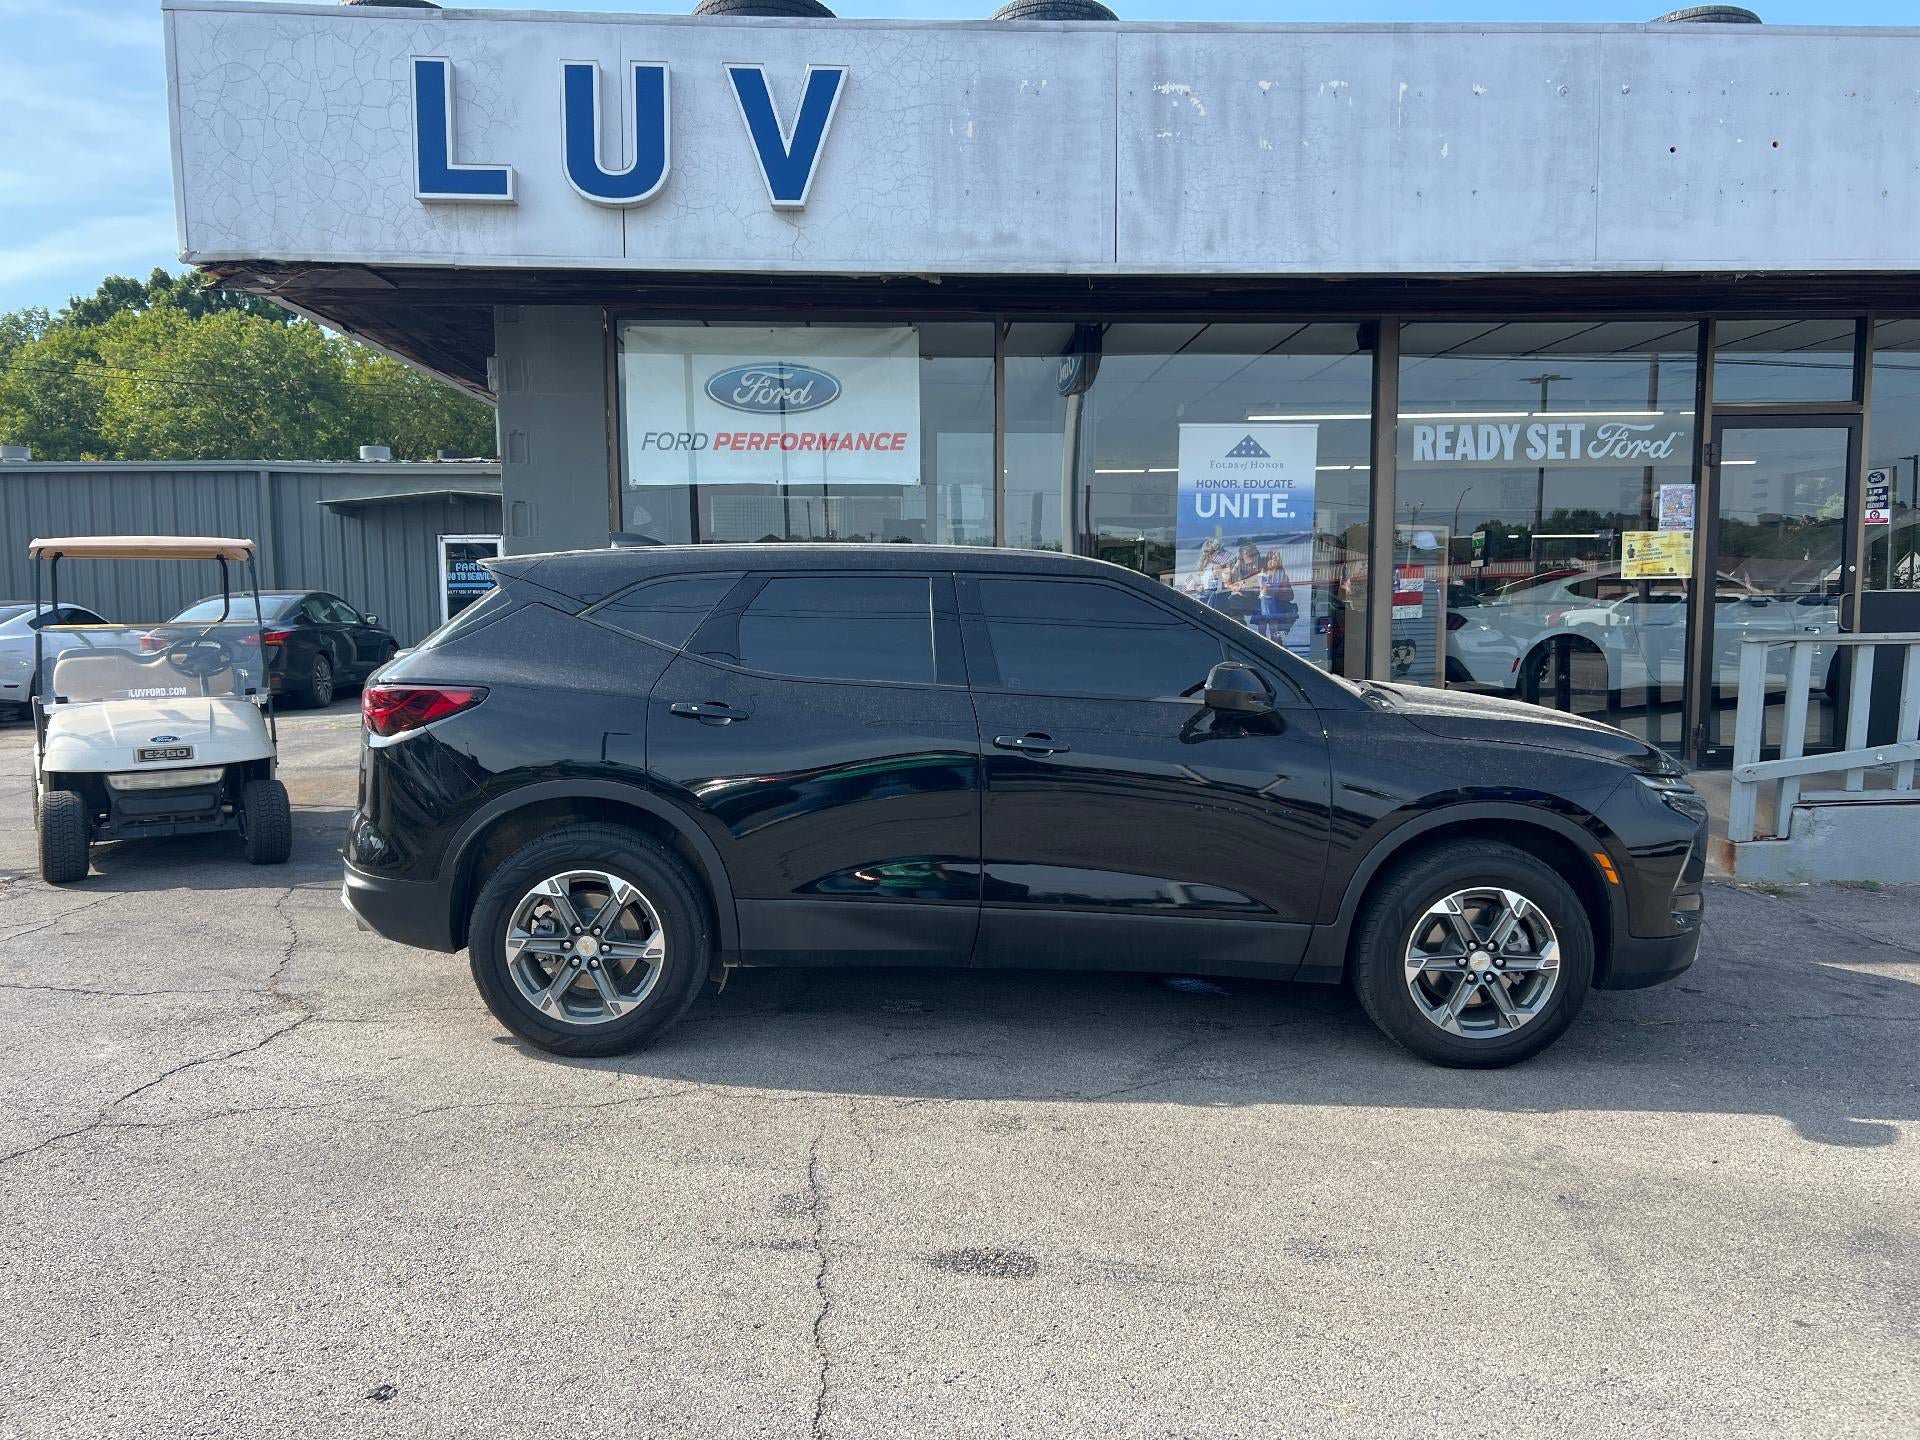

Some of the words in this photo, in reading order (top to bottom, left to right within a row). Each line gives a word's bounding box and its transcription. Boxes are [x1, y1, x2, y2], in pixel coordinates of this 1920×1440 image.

[410, 55, 849, 212] LUV
[733, 371, 815, 405] Ford
[641, 432, 709, 451] FORD
[713, 432, 908, 451] PERFORMANCE
[1413, 424, 1521, 461] READY
[1526, 423, 1585, 461] SET
[1587, 422, 1678, 459] Ford
[1240, 461, 1248, 471] of
[1196, 480, 1240, 489] HONOR.
[1243, 480, 1296, 489] EDUCATE.
[1195, 493, 1296, 518] UNITE.
[456, 563, 481, 571] PART
[468, 572, 494, 580] SERVIC
